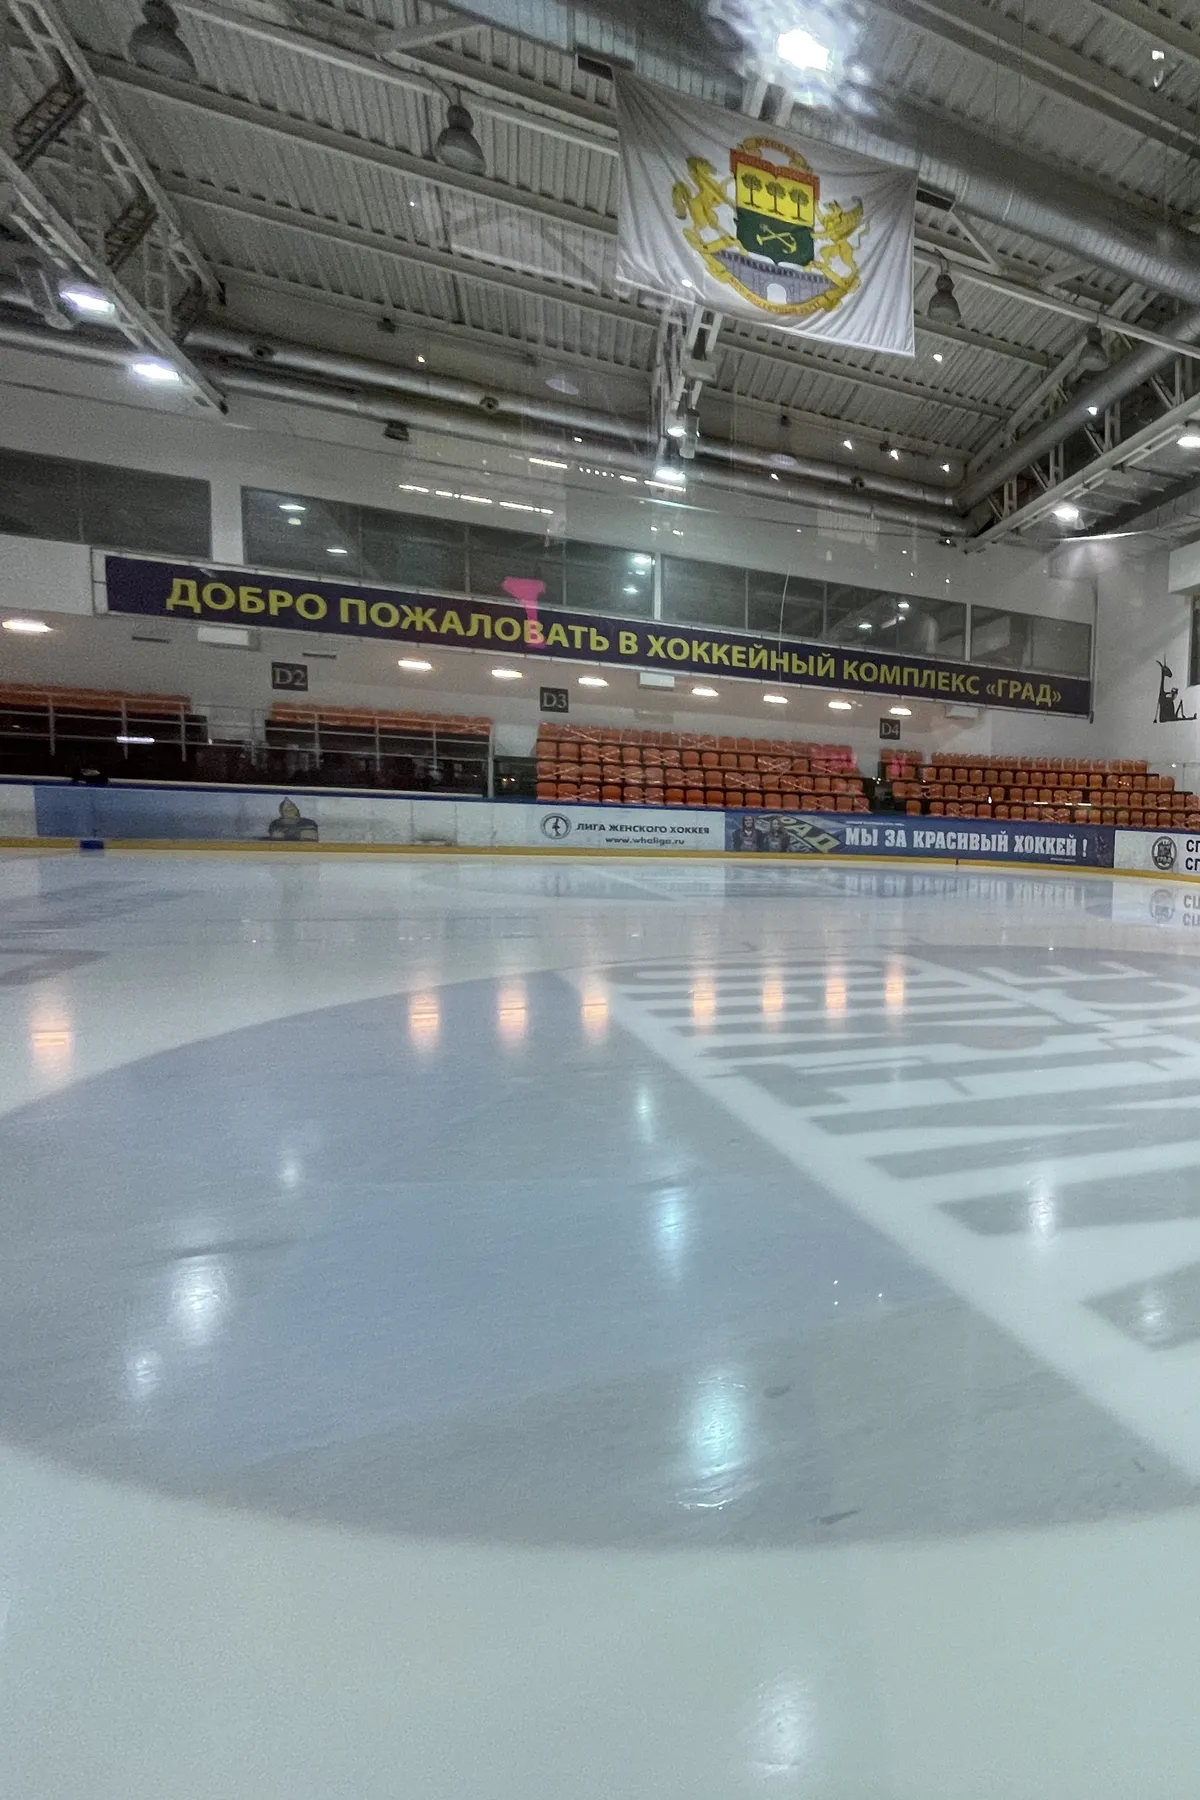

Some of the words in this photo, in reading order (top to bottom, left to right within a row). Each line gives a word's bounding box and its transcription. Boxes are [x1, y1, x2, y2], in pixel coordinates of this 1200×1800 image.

[165, 577, 327, 621] ДОБРО
[339, 597, 608, 653] ПОЖАЛОВАТЬ
[618, 630, 639, 654] В
[645, 634, 836, 679] ХОККЕЙНЫЙ
[842, 661, 980, 696] КОМПЛЕКС
[985, 679, 1062, 706] «ГРАД»
[273, 667, 306, 686] D2
[543, 692, 568, 709] D3
[881, 722, 900, 736] D4
[576, 822, 606, 832] ЛИГА
[608, 823, 668, 834] ЖЕНСКОГО
[669, 826, 710, 834] ХОККЕЯ
[845, 827, 878, 846] МЫ
[884, 829, 907, 847] ЗА
[913, 830, 1008, 852] КРАСИВЫЙ
[1013, 833, 1077, 856] ХОККЕЙ
